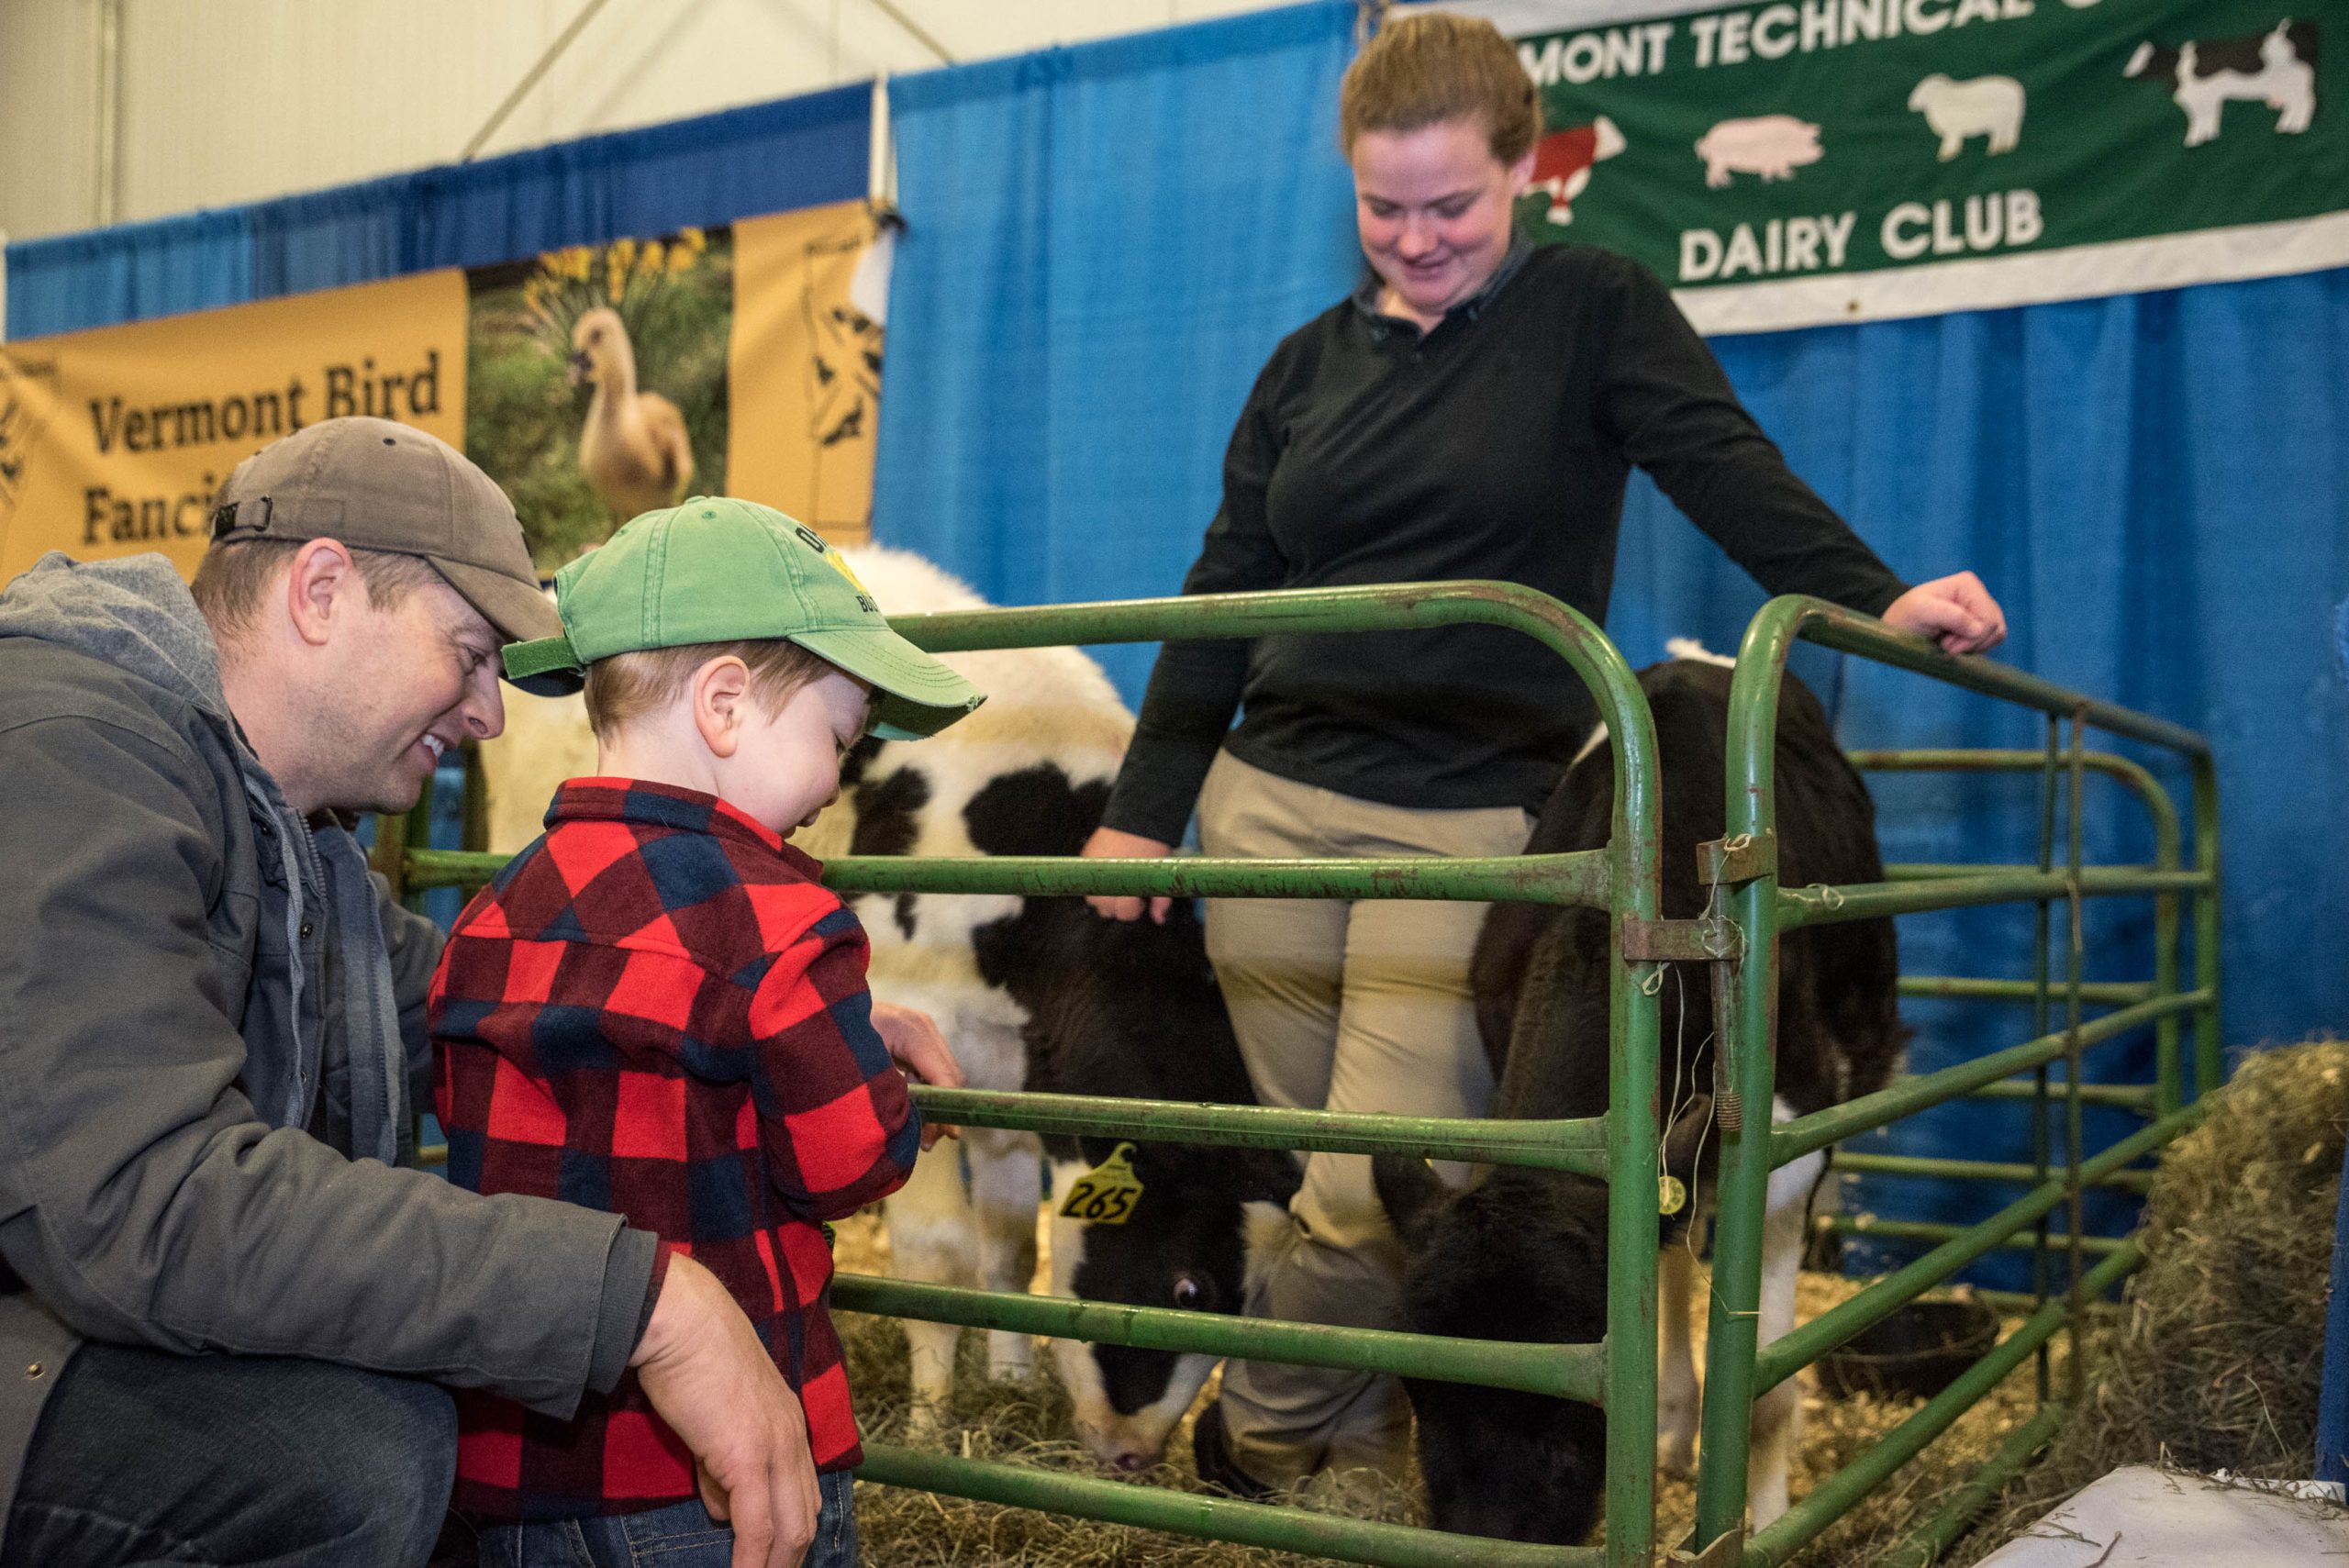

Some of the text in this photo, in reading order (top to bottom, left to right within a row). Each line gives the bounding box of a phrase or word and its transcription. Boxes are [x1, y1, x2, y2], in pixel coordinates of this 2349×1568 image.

[1519, 25, 1673, 86] MONT
[1679, 190, 2044, 281] DAIRY CLUB
[89, 349, 440, 454] Vermont Bird
[83, 472, 215, 545] Fanci
[1059, 1182, 1138, 1219] 265
